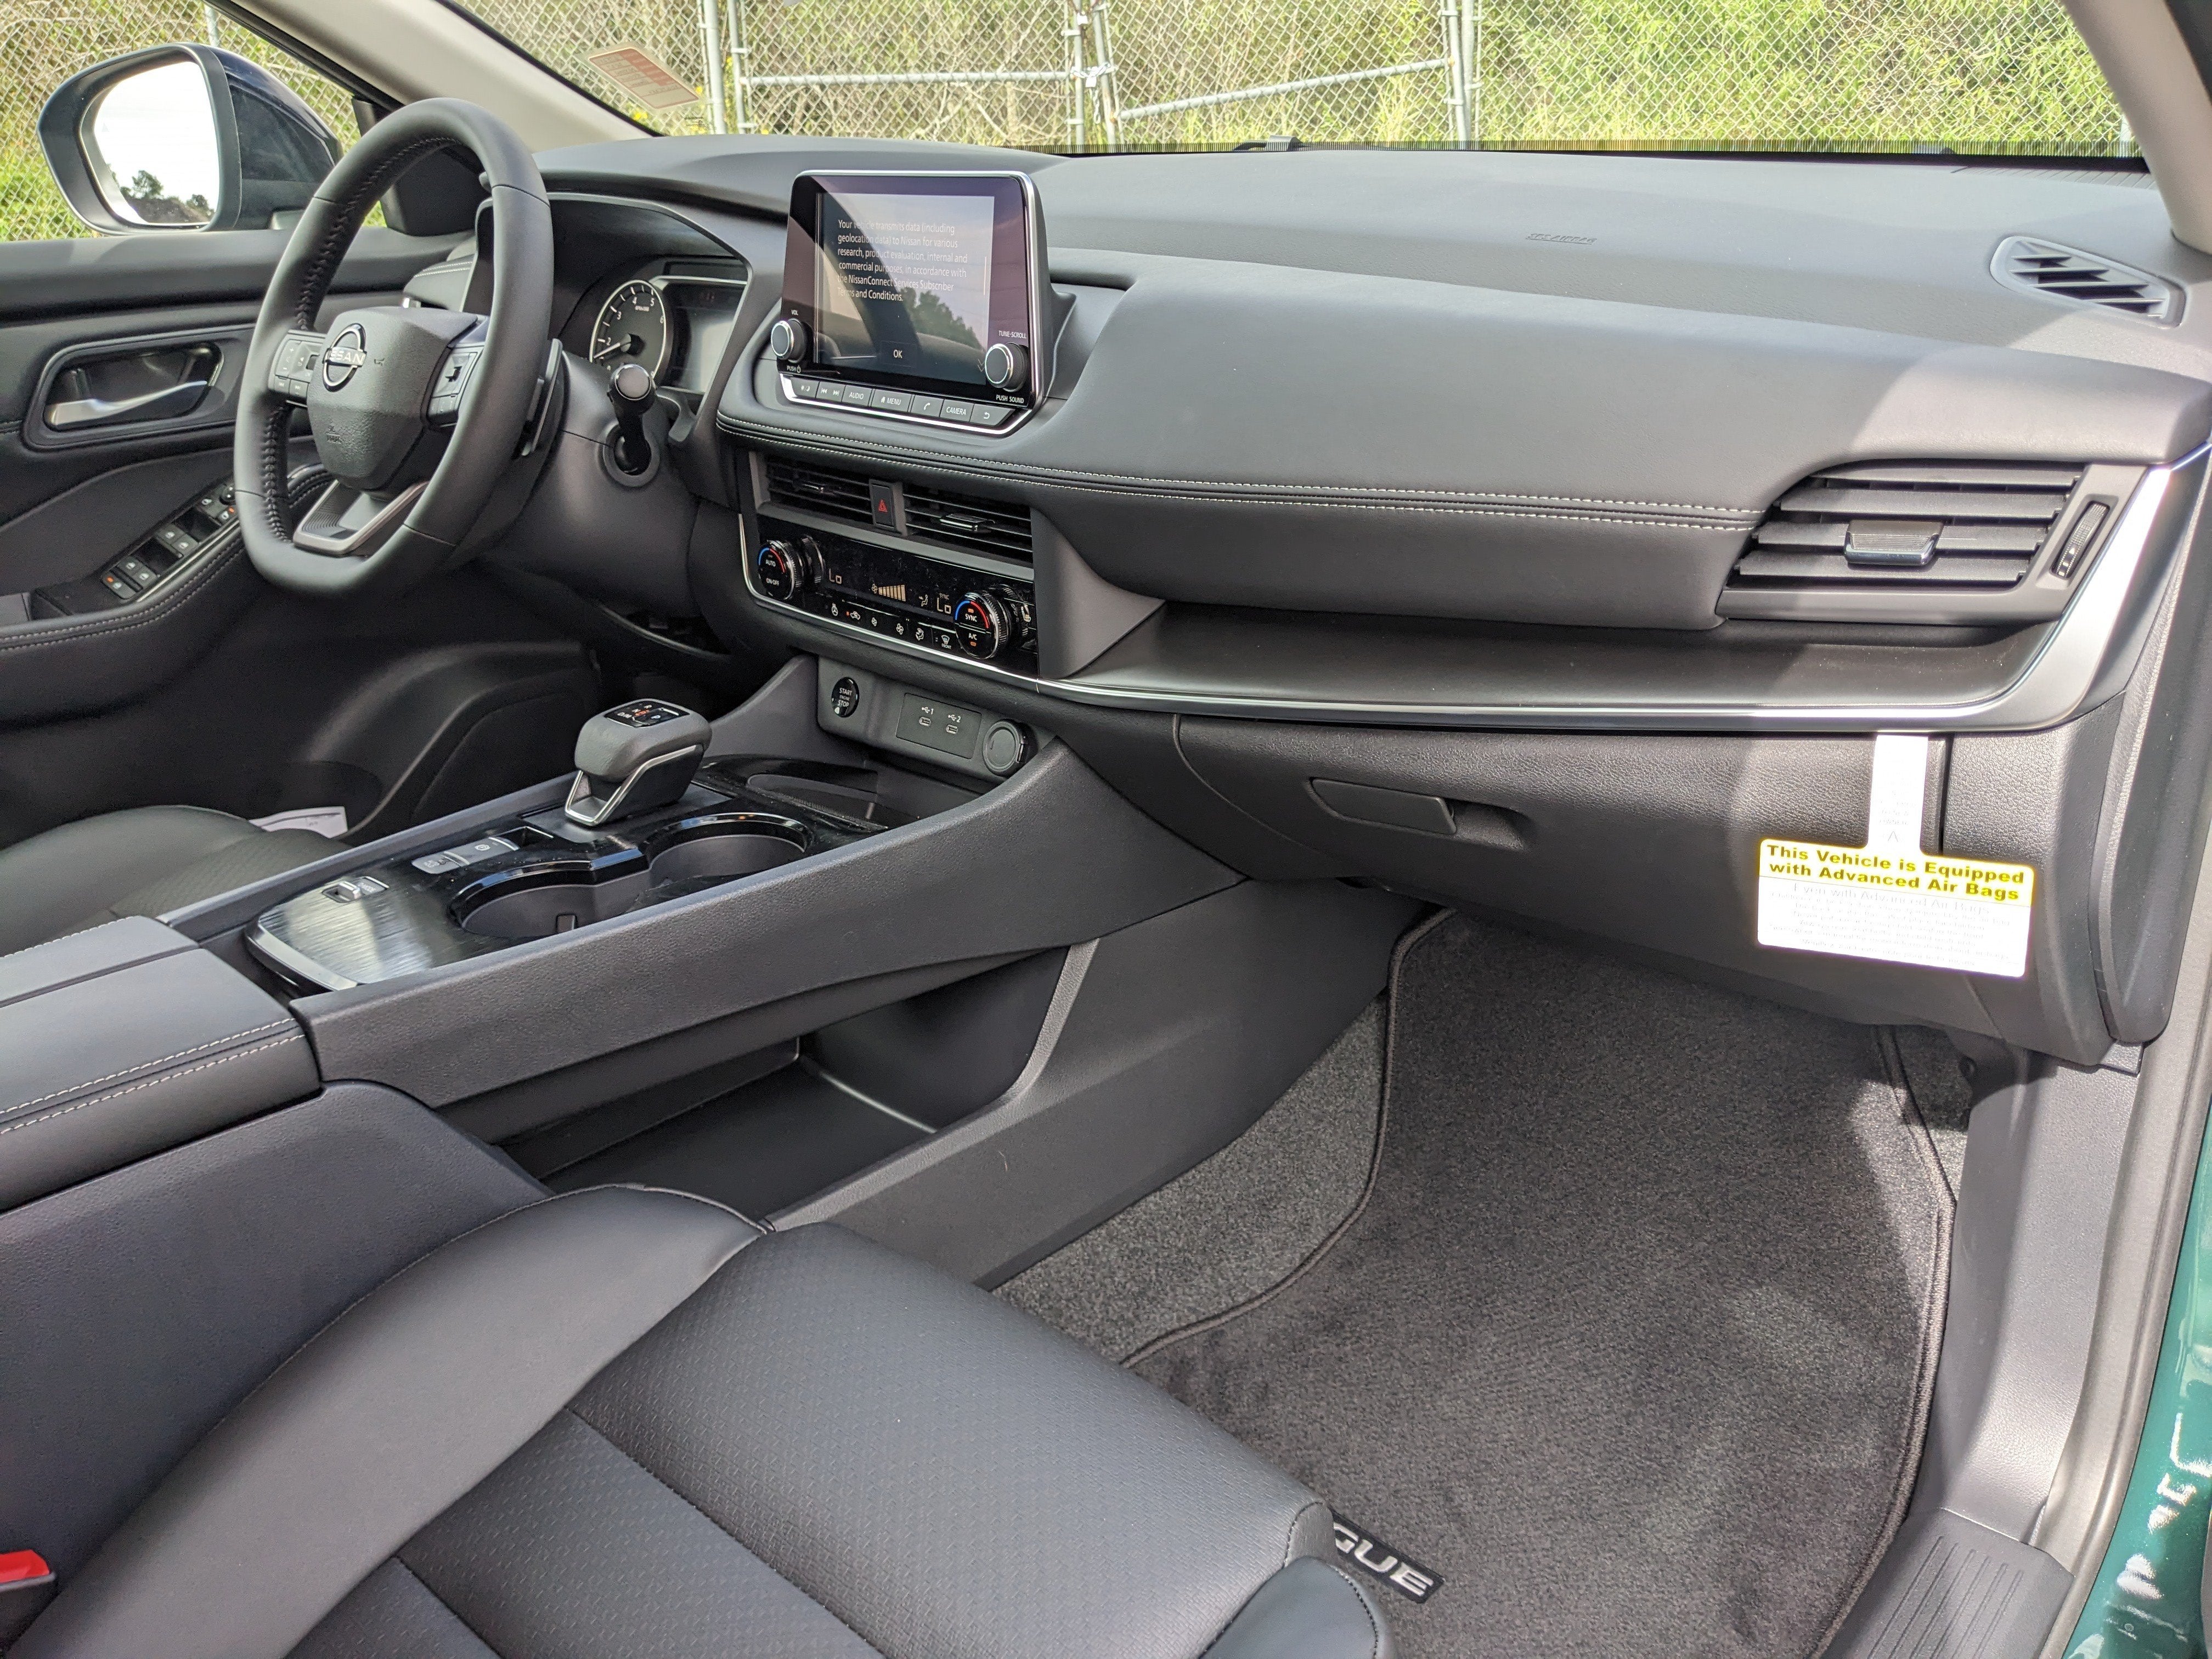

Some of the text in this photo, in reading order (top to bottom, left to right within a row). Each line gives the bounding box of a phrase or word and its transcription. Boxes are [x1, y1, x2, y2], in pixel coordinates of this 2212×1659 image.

[838, 219, 853, 229] Your
[876, 222, 904, 231] transmits
[906, 222, 920, 232] data
[838, 233, 874, 244] geolocation
[893, 236, 899, 245] to
[901, 236, 921, 246] Nissan
[923, 236, 932, 246] for
[934, 238, 958, 248] various
[837, 247, 864, 258] research,
[865, 249, 889, 259] product
[927, 252, 953, 262] internal
[955, 253, 968, 263] and
[839, 262, 967, 278] commercial purposes, in accordance with
[838, 274, 954, 291] the NissanConnect Services Subscriber
[837, 287, 904, 302] Terms and Conditions.
[329, 349, 366, 365] SSAN
[893, 350, 903, 359] OK
[849, 391, 864, 400] AUDIO
[887, 397, 902, 406] MENU
[946, 406, 967, 416] CAMERA
[765, 558, 776, 567] AUTO
[965, 613, 978, 623] SYNC
[968, 632, 978, 641] A/C
[839, 687, 853, 696] START
[1767, 844, 2024, 884] This Vehicle is Equipped
[1769, 862, 2019, 901] with Advanced Air Bags
